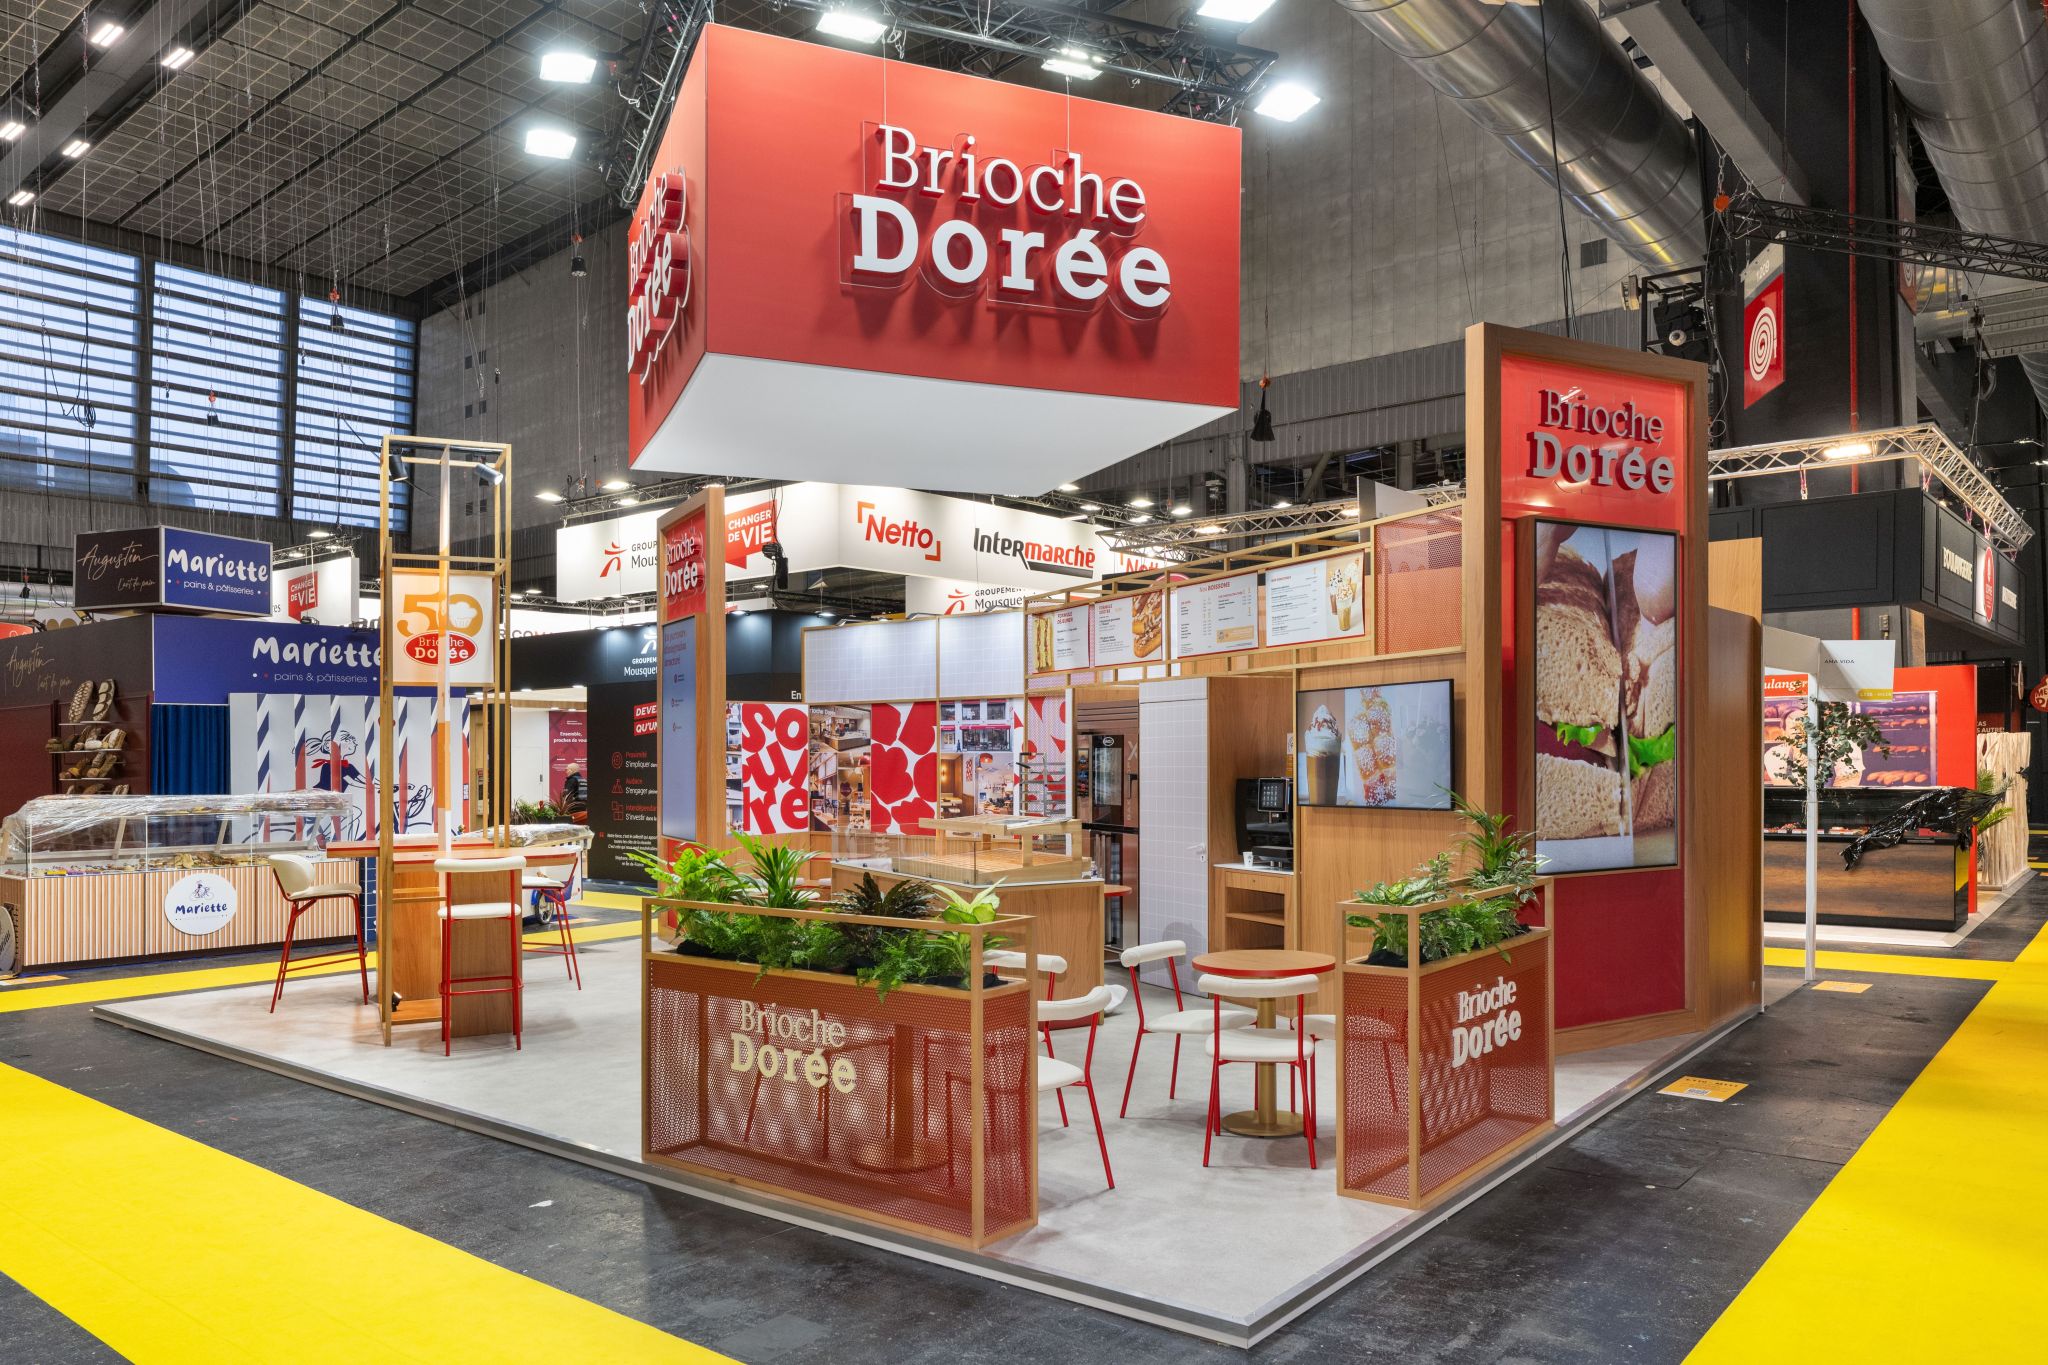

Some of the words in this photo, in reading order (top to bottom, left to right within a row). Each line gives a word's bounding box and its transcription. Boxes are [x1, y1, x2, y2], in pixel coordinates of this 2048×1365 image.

[878, 123, 1146, 224] Brioche
[629, 172, 668, 296] Brioche
[852, 194, 1171, 308] Dorée
[627, 231, 673, 374] Dorée
[1543, 388, 1665, 443] Brioche
[1533, 431, 1675, 493] Dorée
[728, 509, 772, 530] CHANGER
[728, 531, 740, 543] DE
[740, 522, 772, 548] VIE
[865, 513, 934, 550] Netto
[77, 540, 160, 580] Augustin
[167, 549, 269, 582] Mariette
[666, 530, 695, 566] Brioche
[973, 527, 1096, 570] Intermarché
[183, 579, 206, 591] pains
[207, 581, 215, 590] &
[215, 582, 255, 596] pâtisseries
[664, 561, 698, 598] Dorée
[252, 636, 381, 667] Mariette
[414, 647, 469, 659] Doée
[418, 636, 465, 647] Briohe
[273, 672, 304, 682] pains
[306, 673, 315, 681] &
[316, 672, 368, 683] pâtisseries
[626, 787, 648, 795] S'engager
[175, 903, 228, 914] Mariette
[1458, 976, 1517, 1023] Brioche
[740, 1000, 846, 1047] Brioche
[1452, 1010, 1522, 1068] Dorée
[730, 1032, 857, 1093] Dorée
